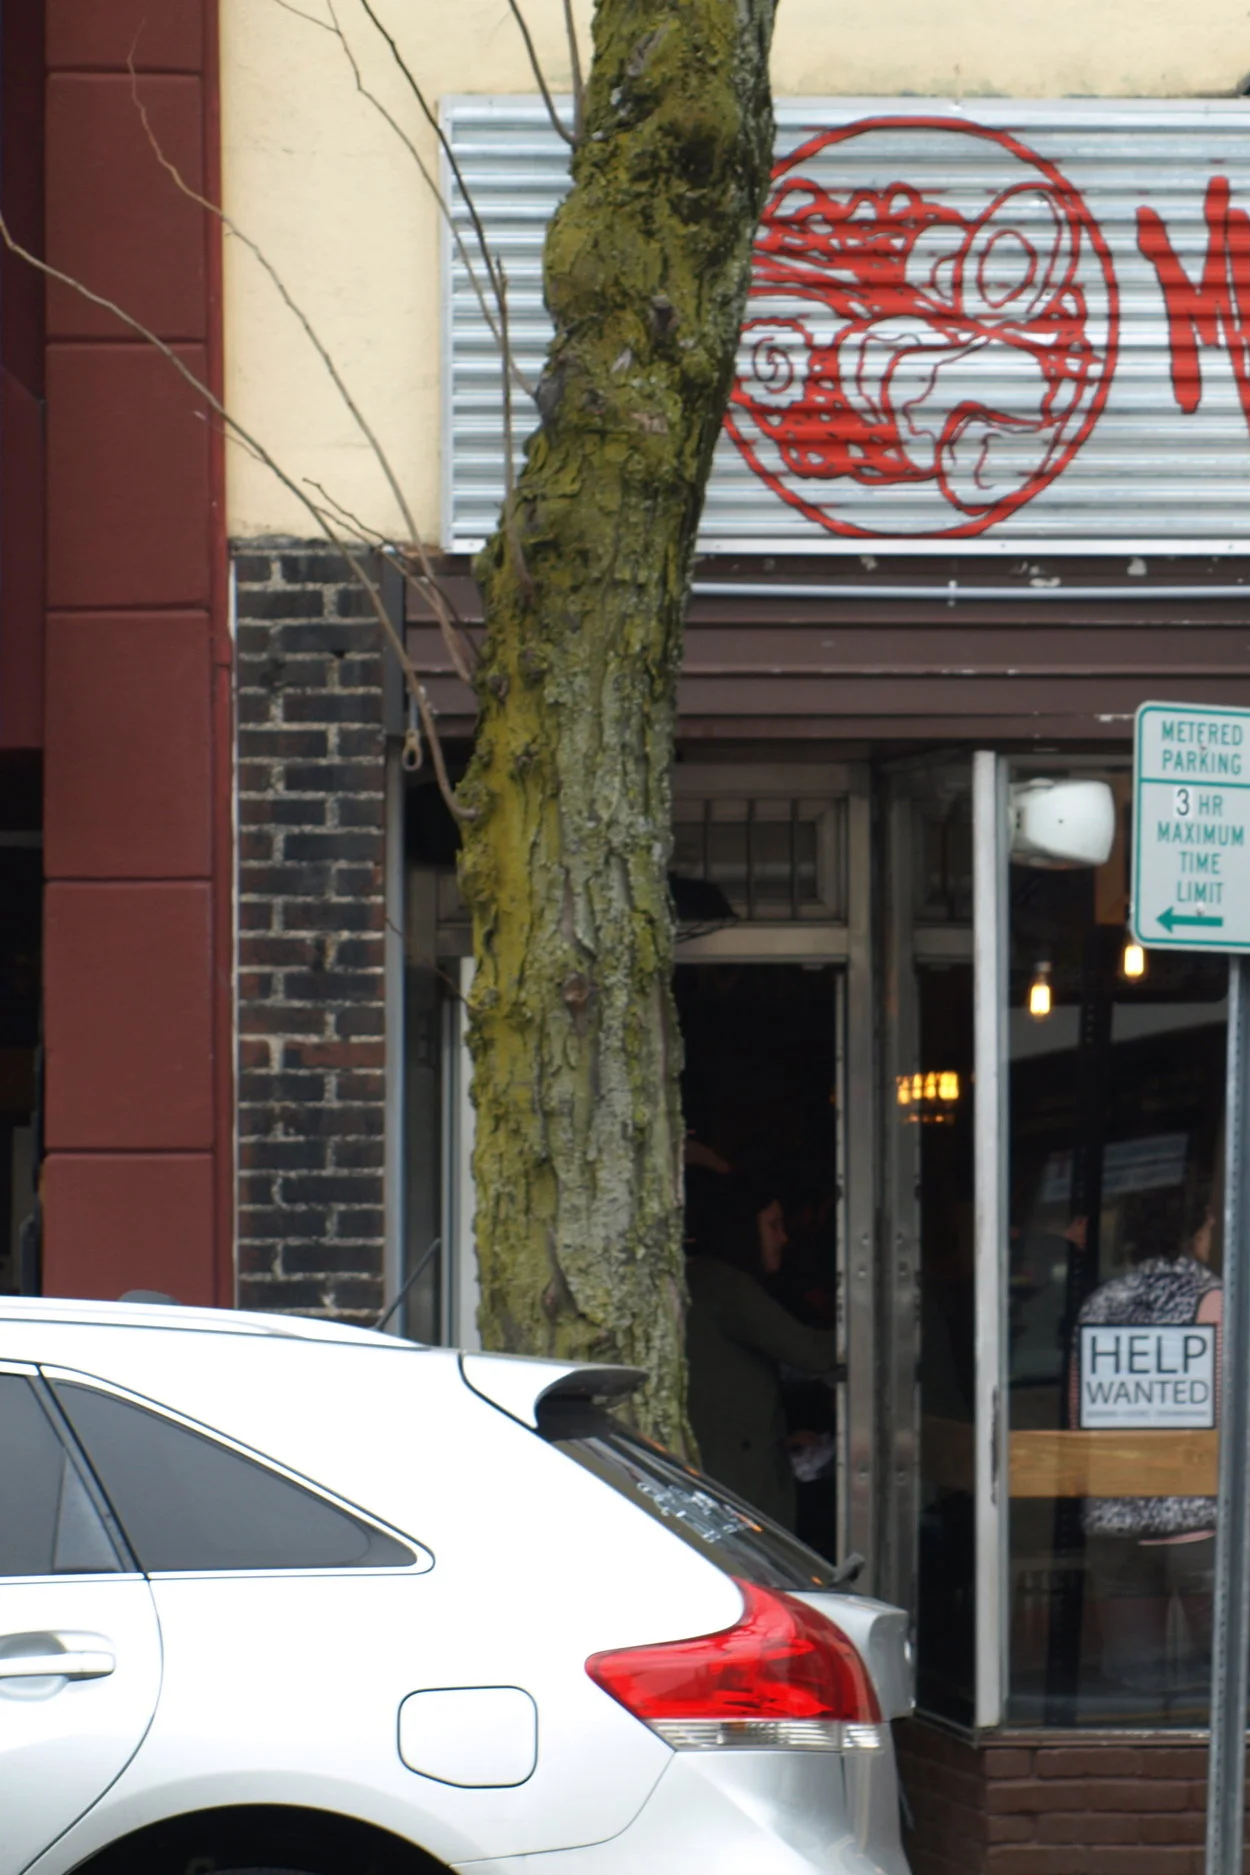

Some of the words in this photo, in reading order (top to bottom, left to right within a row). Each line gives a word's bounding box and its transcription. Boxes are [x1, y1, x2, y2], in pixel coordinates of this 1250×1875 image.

[1161, 720, 1243, 746] METERED
[1162, 749, 1242, 776] PARKING
[1176, 788, 1190, 816] 3
[1199, 794, 1224, 816] HR
[1157, 821, 1244, 846] MAXIMUM
[1180, 851, 1221, 874] TIME
[1176, 881, 1224, 904] LIMIT
[1090, 1335, 1208, 1375] HELP
[1086, 1381, 1208, 1405] WANTED
